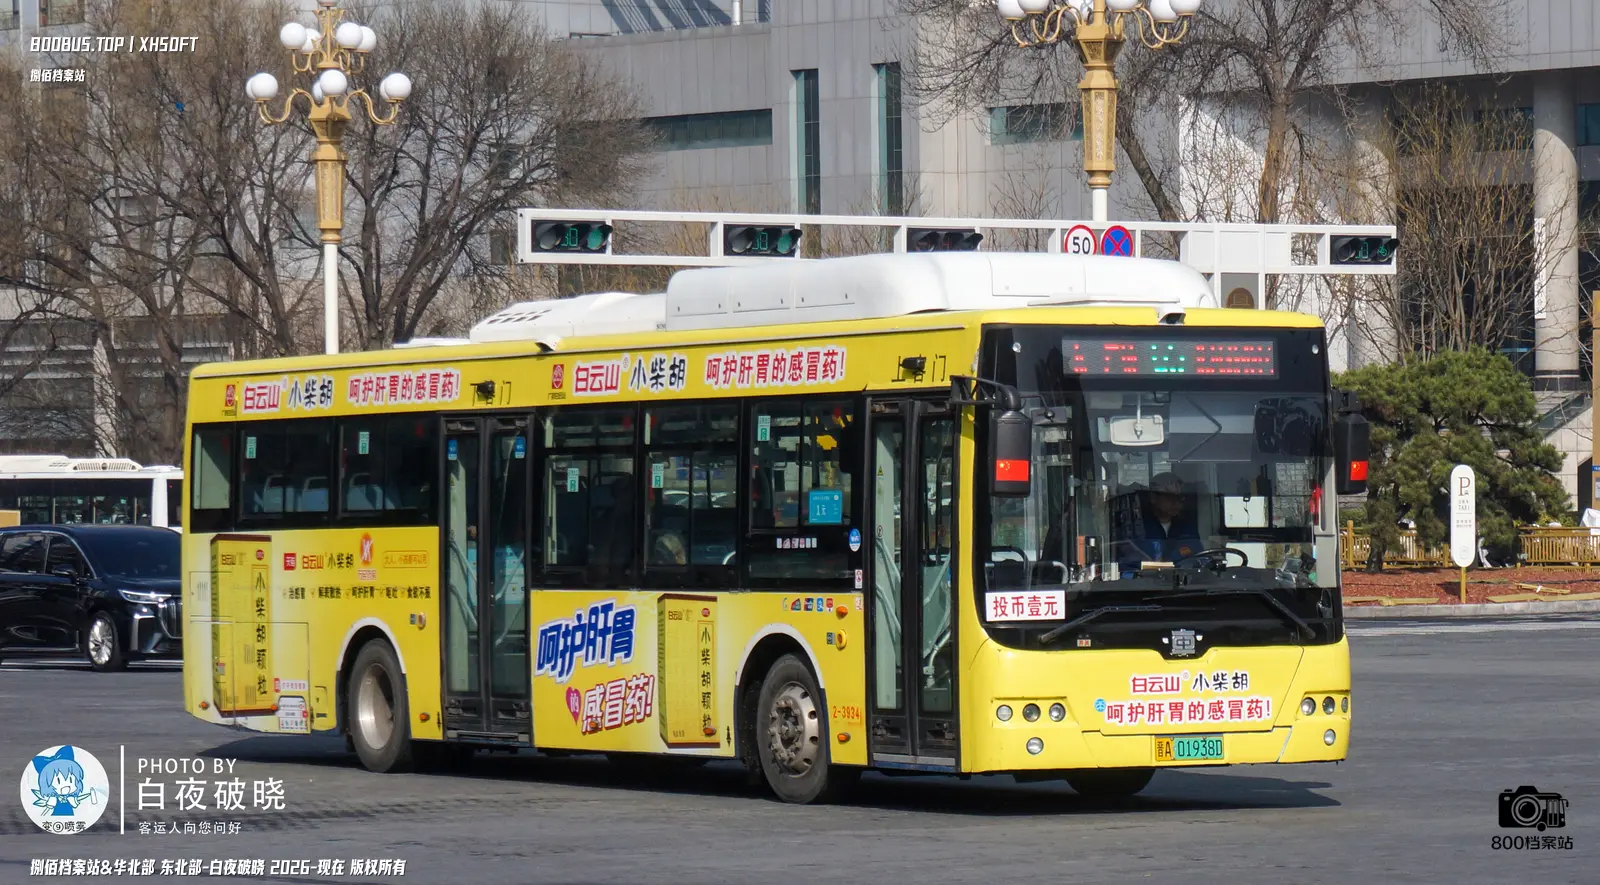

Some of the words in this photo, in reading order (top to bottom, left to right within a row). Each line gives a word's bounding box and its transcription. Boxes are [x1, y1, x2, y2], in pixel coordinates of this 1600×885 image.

[1072, 236, 1091, 255] 50
[575, 363, 620, 393] 白云山
[630, 356, 686, 390] 小柴胡
[244, 384, 281, 411] 白云山
[288, 377, 333, 408] 小柴胡
[1458, 476, 1471, 497] P
[992, 594, 1058, 618] 投币壹元
[537, 602, 635, 679] 呵护肝胃
[1131, 675, 1180, 694] 白云山
[1192, 671, 1249, 692] 小柴胡
[832, 704, 861, 720] 2-3934
